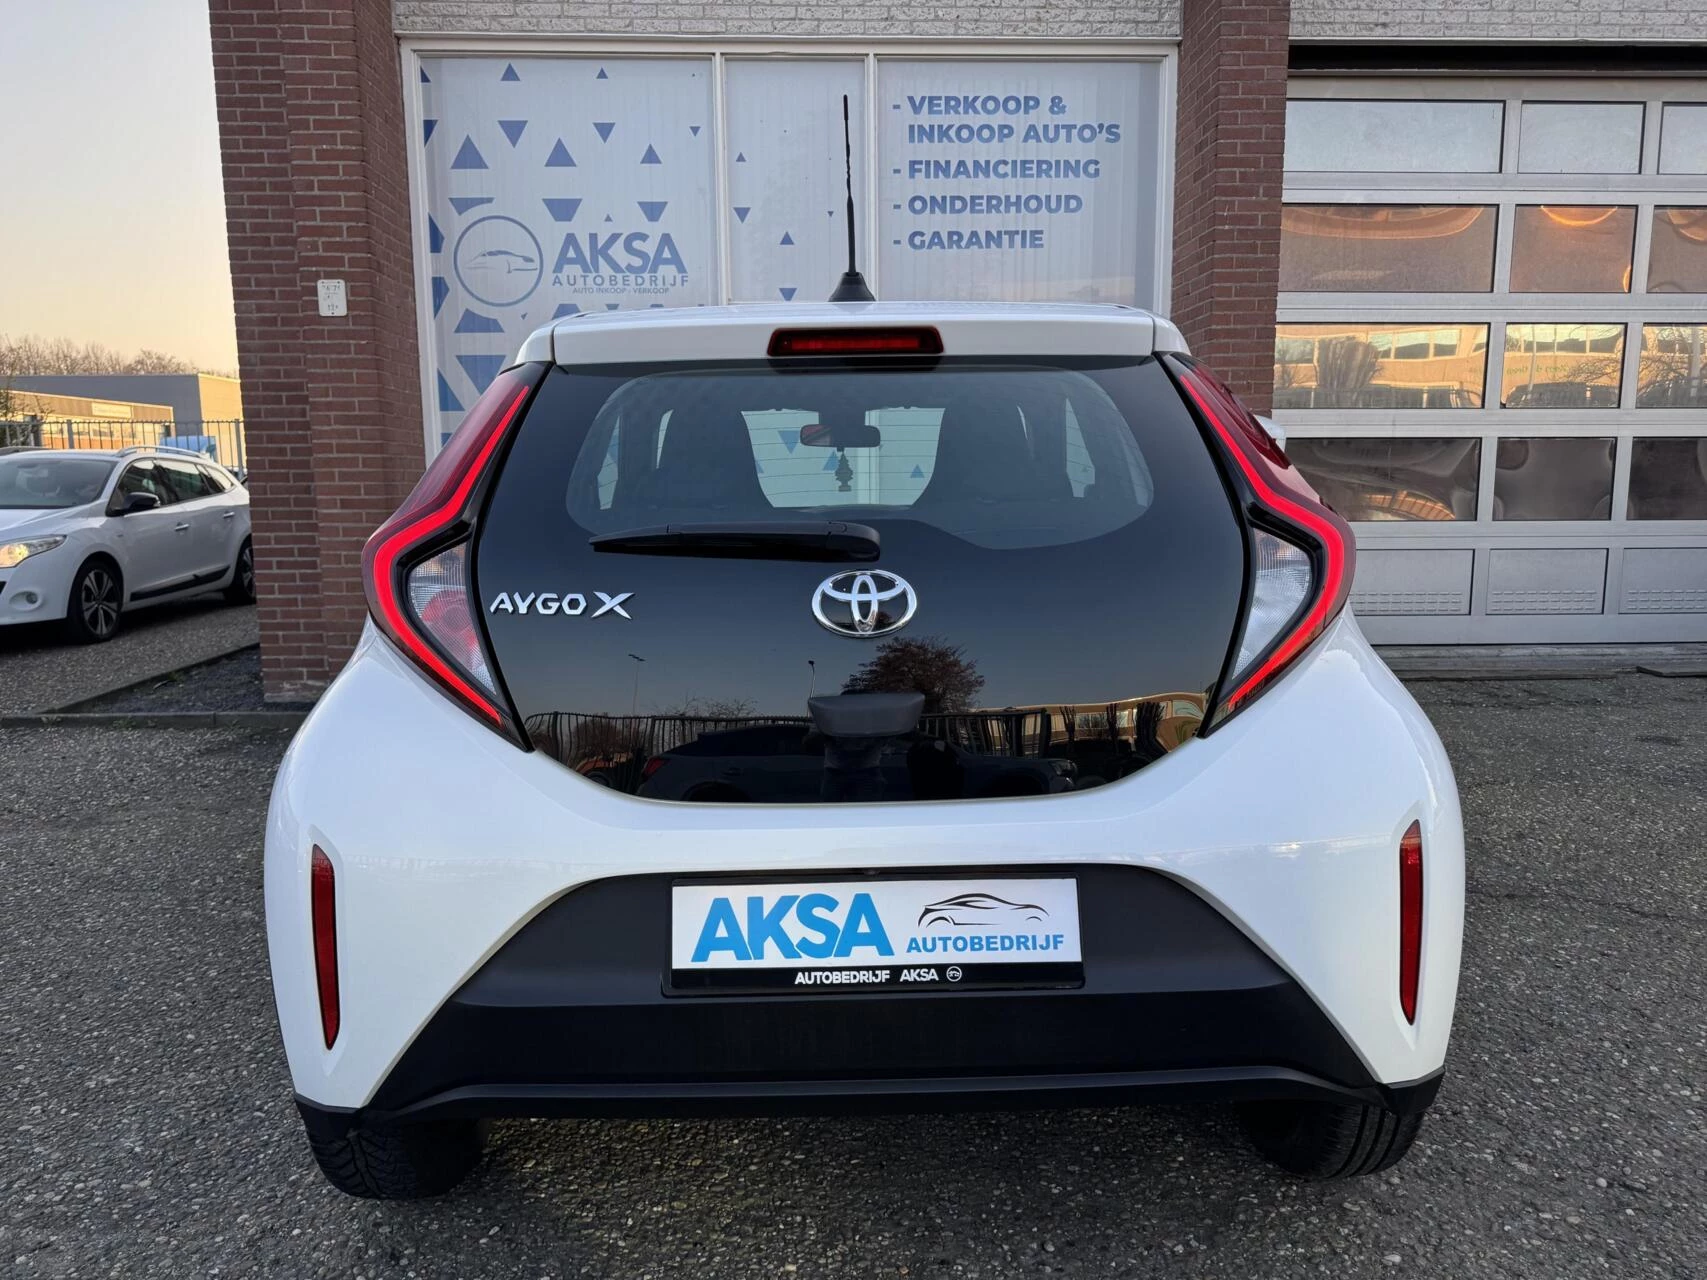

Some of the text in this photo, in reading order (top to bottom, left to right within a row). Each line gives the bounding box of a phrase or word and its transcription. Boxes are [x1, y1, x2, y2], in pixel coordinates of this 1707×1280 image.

[907, 95, 1041, 115] VERKOOP
[1048, 95, 1067, 115] &
[908, 123, 1121, 143] INKOOP AUTO'S
[908, 159, 1101, 179] FINANCIERING
[908, 194, 1083, 215] ONDERHOUD
[908, 229, 1044, 250] GARANTIE
[552, 232, 688, 274] AKSA
[552, 274, 689, 287] AUTOBEDRIJF
[489, 591, 635, 620] AYGO X
[691, 893, 895, 963] AKSA
[906, 934, 1065, 953] AUTOBEDRIJF
[794, 968, 939, 985] AUTOBEDRIJF AKSA
